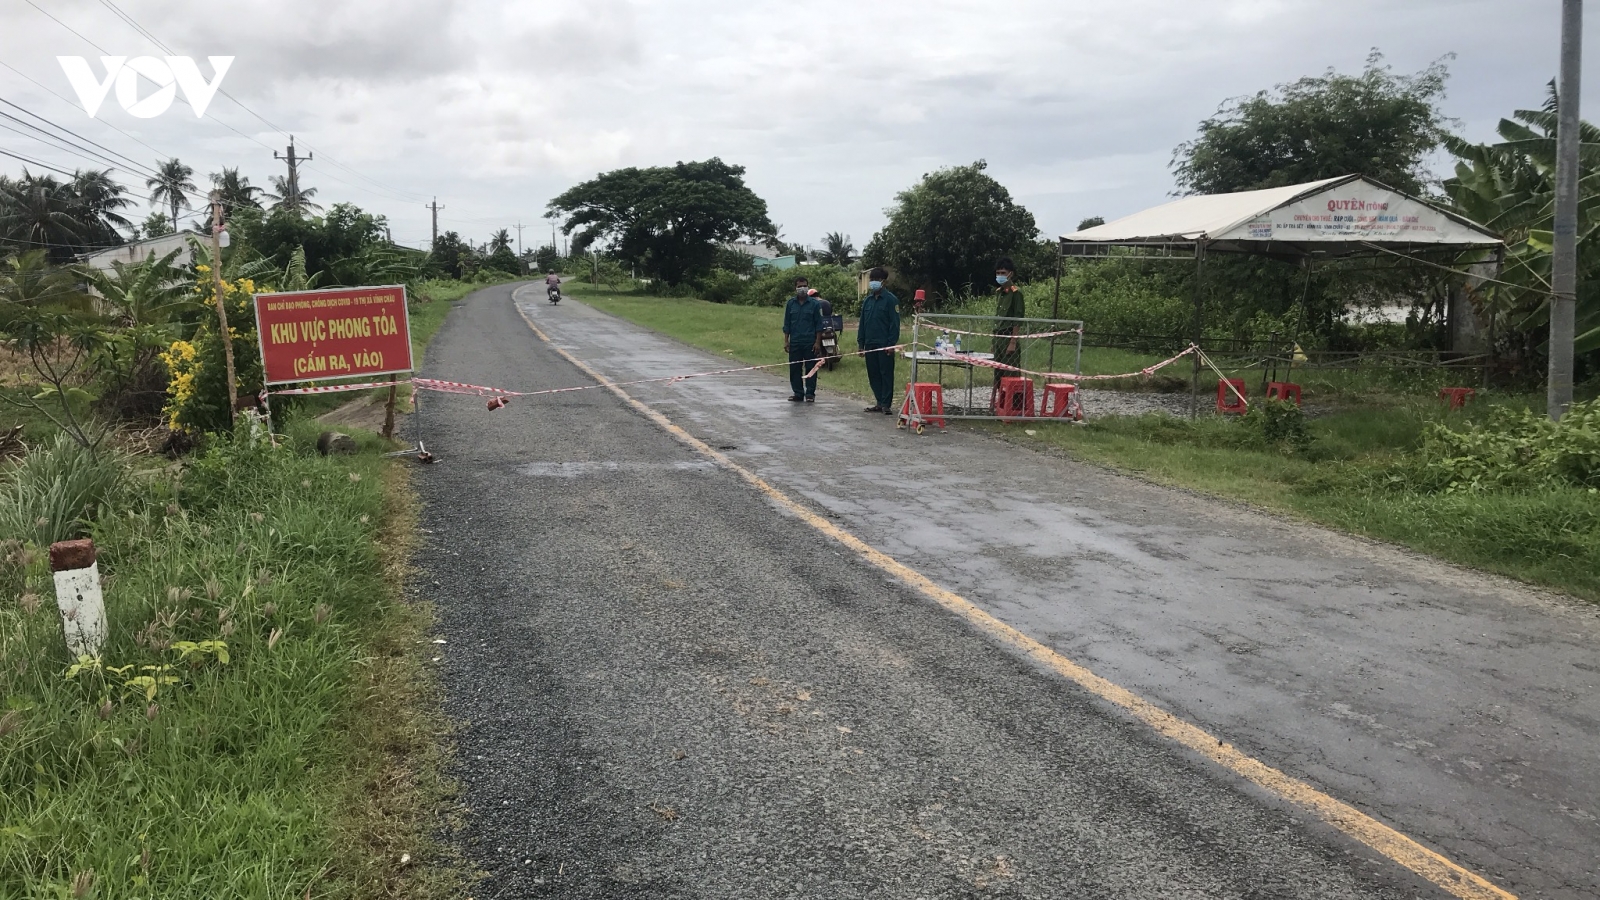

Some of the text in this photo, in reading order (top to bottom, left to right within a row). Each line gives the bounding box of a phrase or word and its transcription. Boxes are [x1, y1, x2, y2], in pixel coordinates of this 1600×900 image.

[267, 302, 277, 311] BAN
[271, 307, 398, 347] KHU VỰC PHONG TỎA
[294, 348, 384, 376] (CẤM RA, VÀO)
